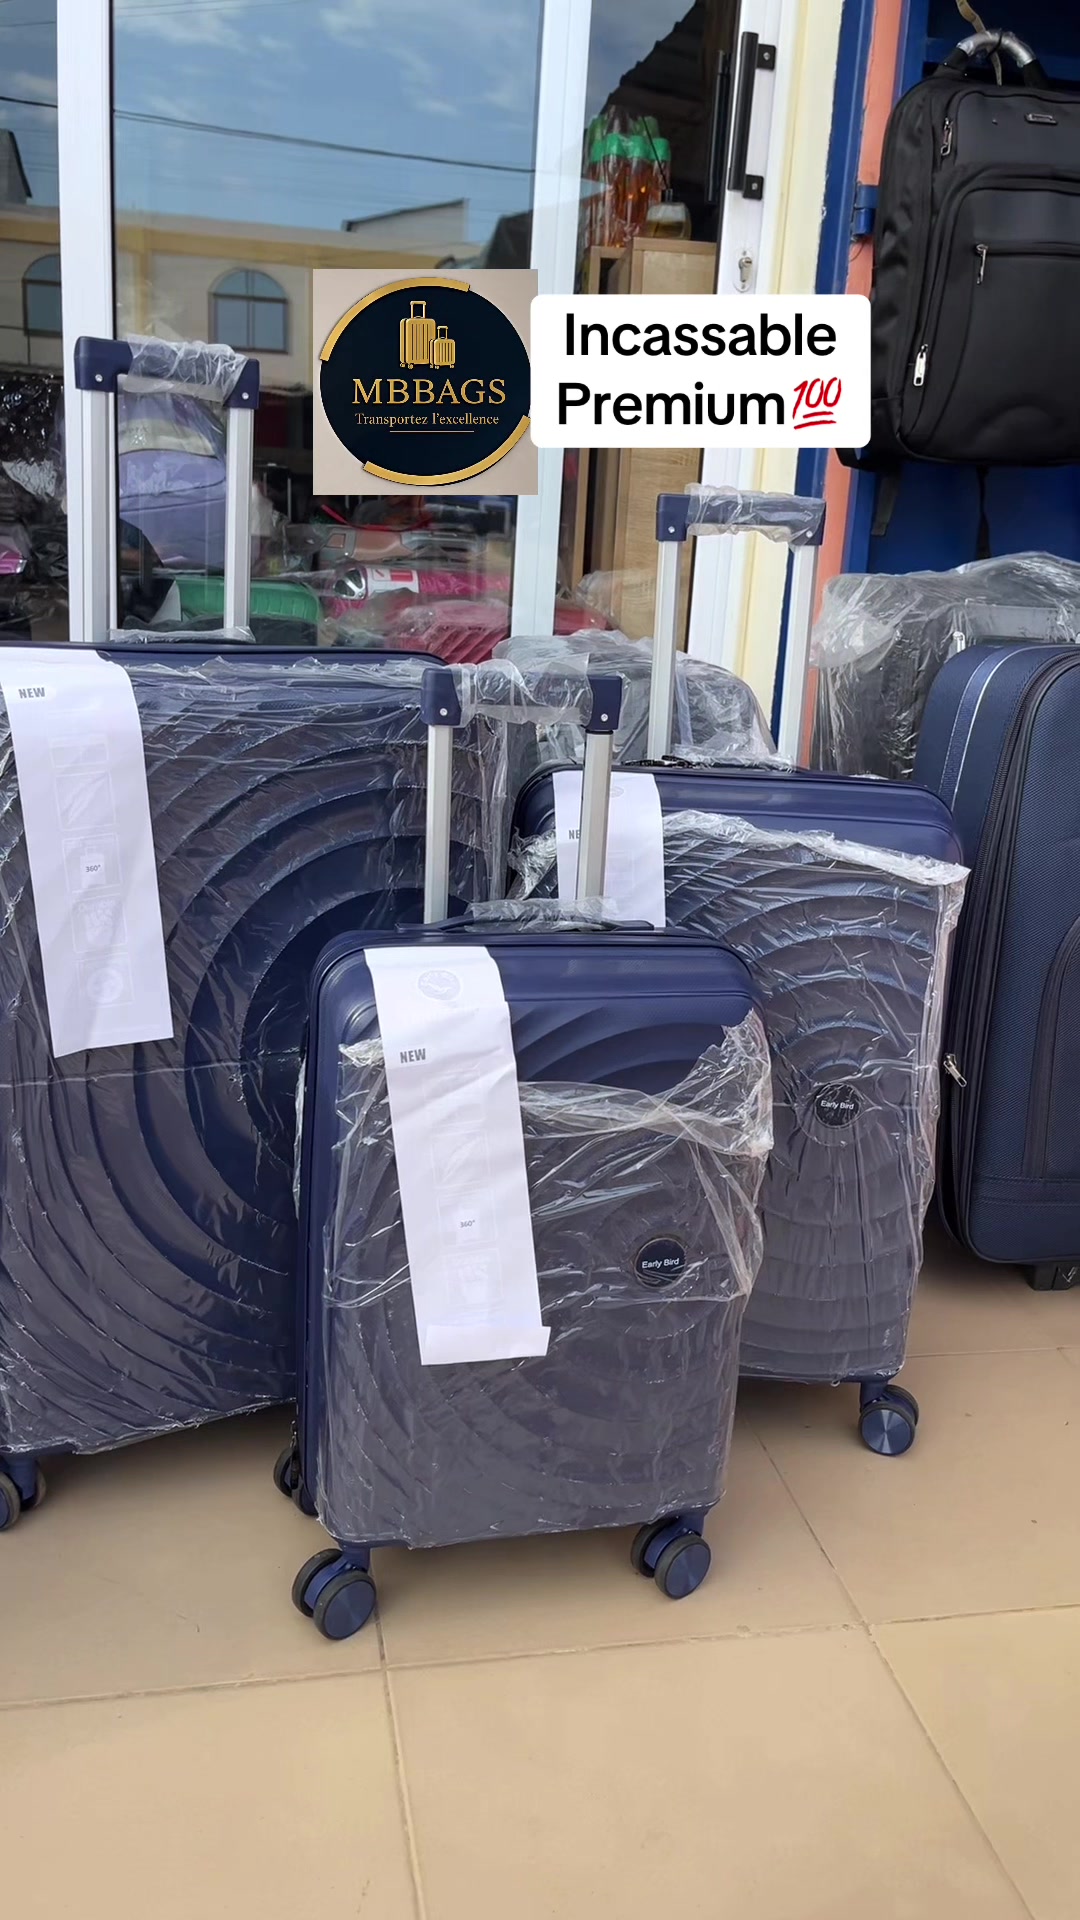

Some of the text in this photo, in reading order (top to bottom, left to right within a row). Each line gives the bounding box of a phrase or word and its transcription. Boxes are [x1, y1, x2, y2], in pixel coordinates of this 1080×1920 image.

[18, 687, 46, 699] NEW
[568, 829, 581, 840] NE
[400, 1048, 426, 1064] NEW
[820, 1100, 855, 1110] Early Bird
[641, 1257, 680, 1269] Early Bird
